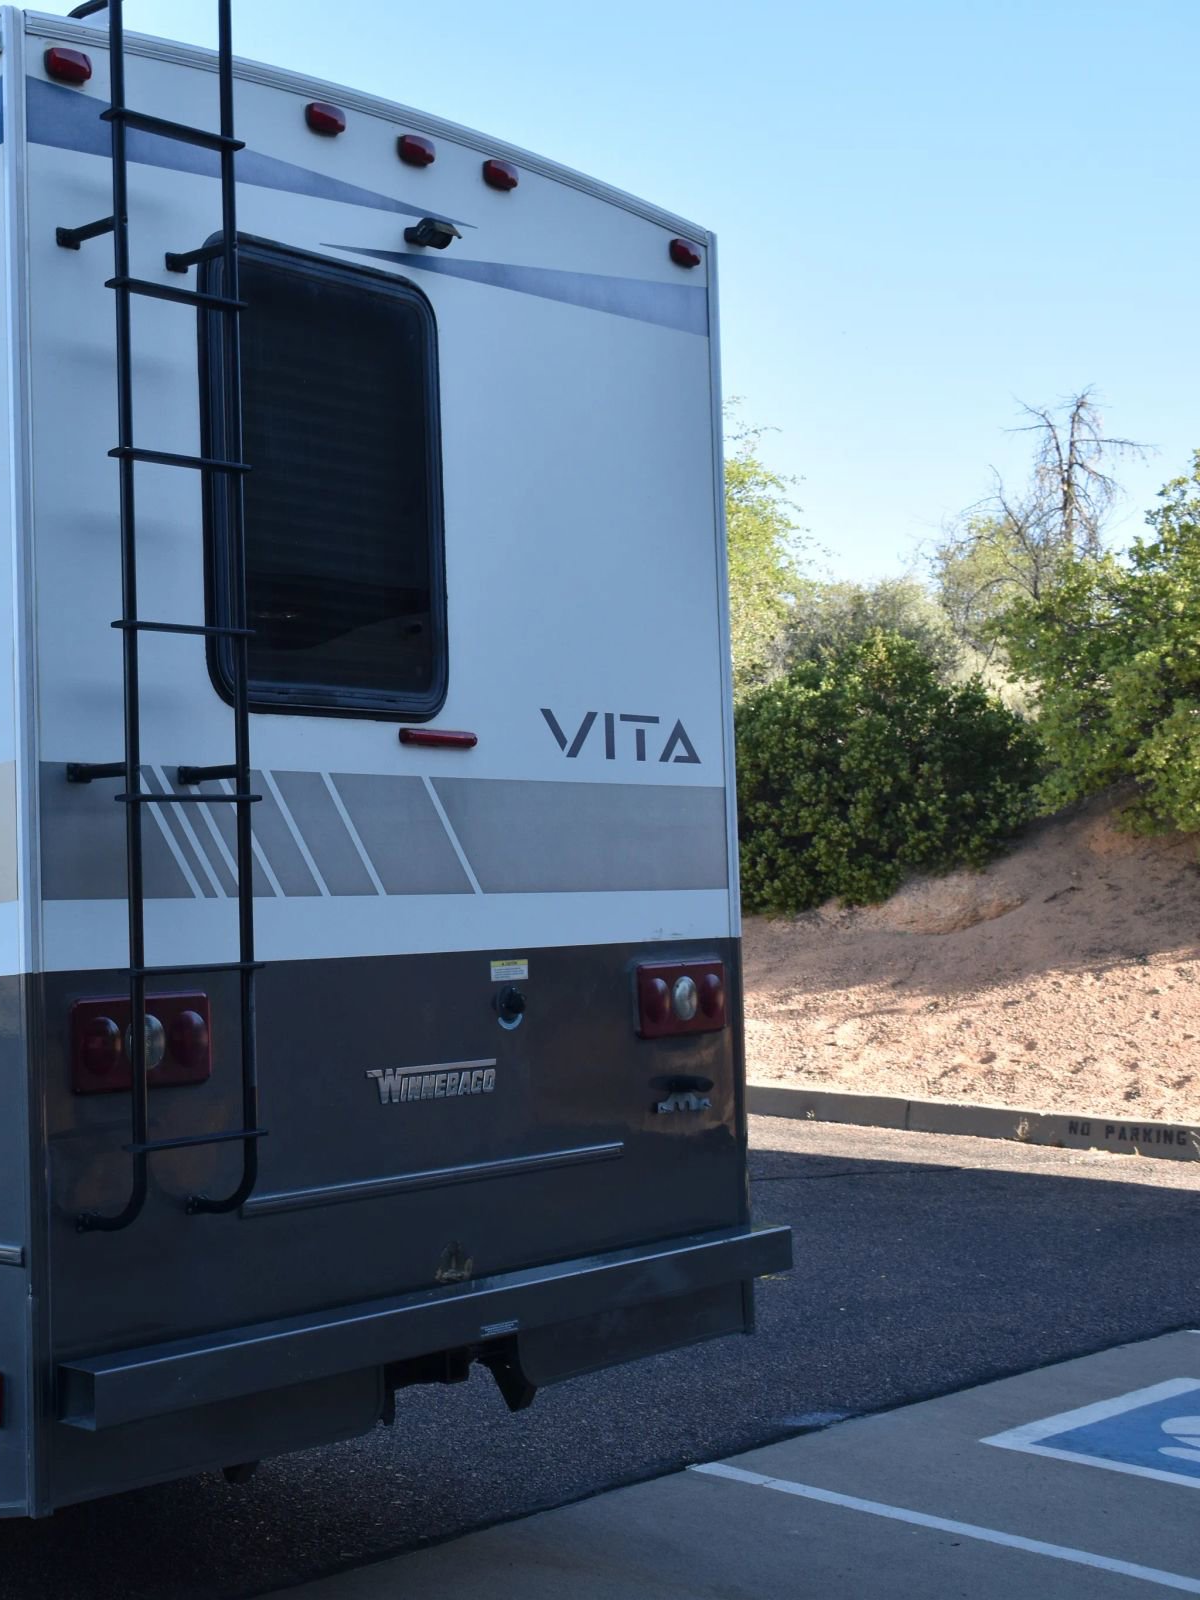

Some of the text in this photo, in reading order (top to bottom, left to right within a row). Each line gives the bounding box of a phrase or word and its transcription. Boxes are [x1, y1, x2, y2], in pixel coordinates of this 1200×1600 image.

[540, 708, 702, 764] VITA
[366, 1058, 497, 1105] WINNEBAGO
[1068, 1121, 1187, 1146] NO PARKING
